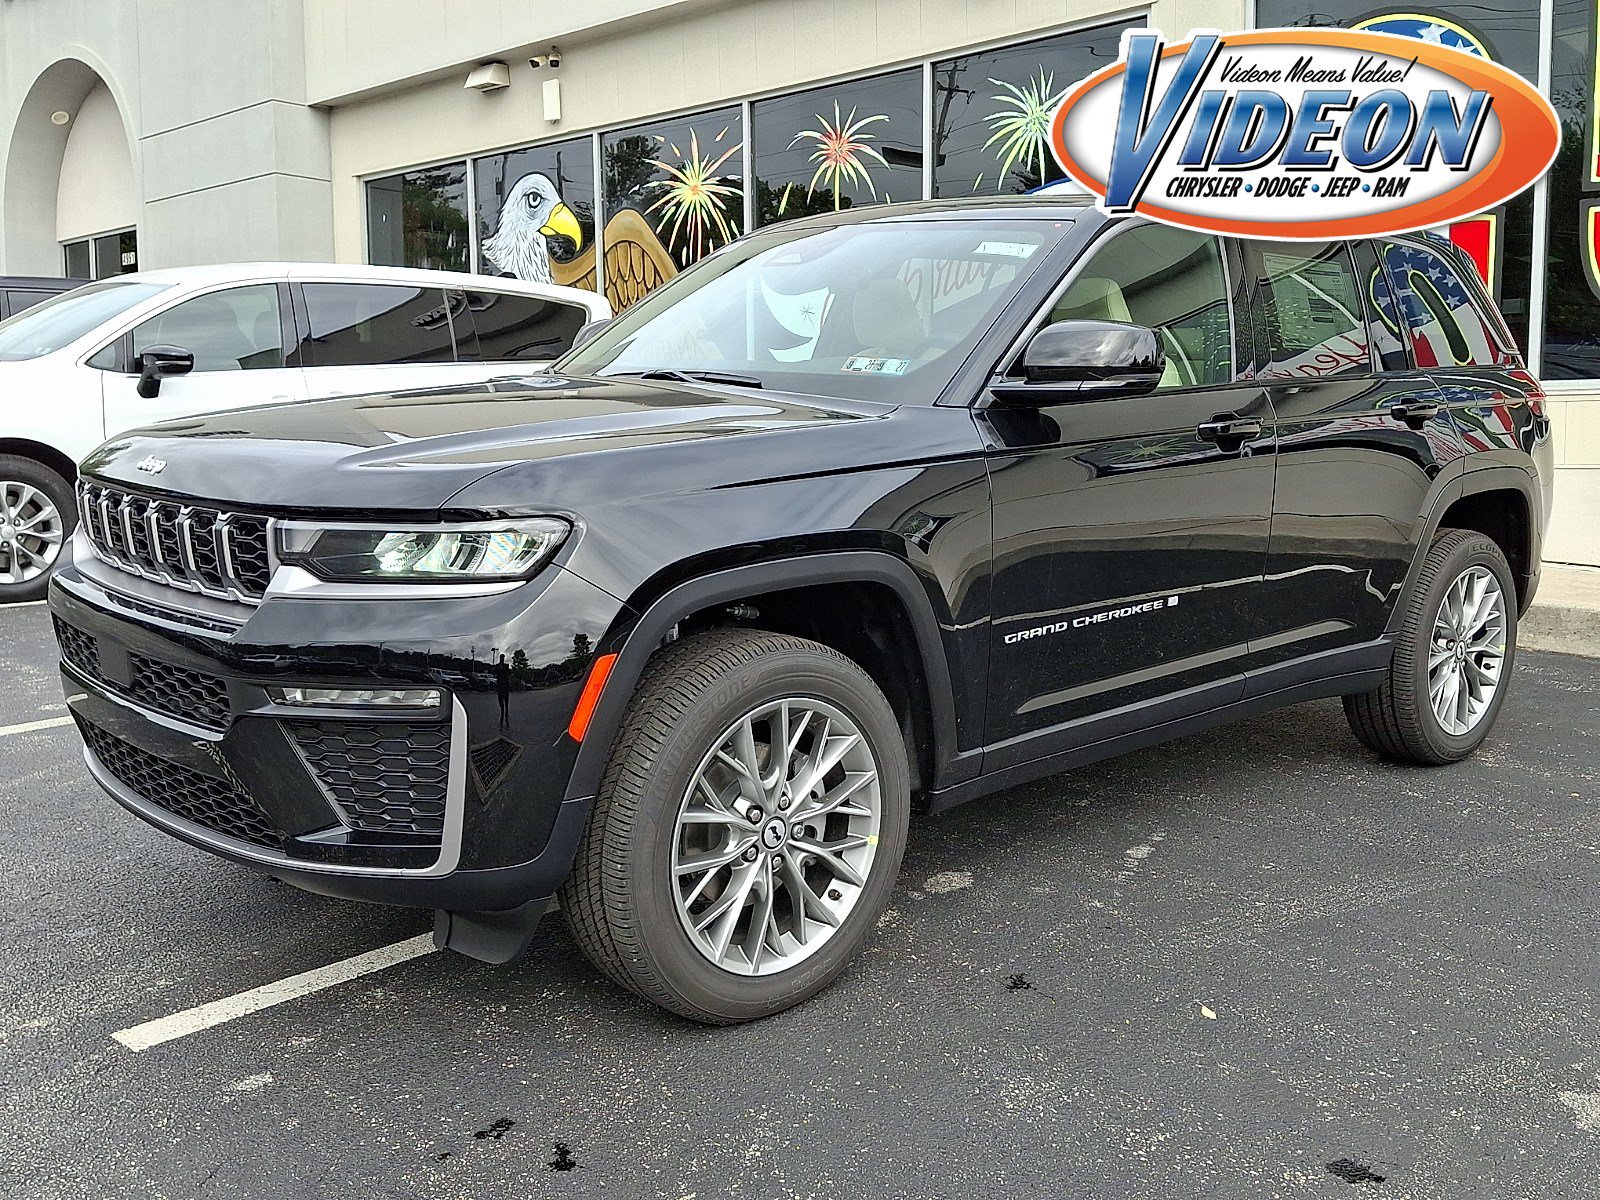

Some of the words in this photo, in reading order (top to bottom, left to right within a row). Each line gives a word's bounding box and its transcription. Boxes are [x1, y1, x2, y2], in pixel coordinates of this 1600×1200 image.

[136, 454, 167, 476] Jeep
[1004, 621, 1068, 645] GRAND
[1072, 600, 1164, 628] CHEROKEE
